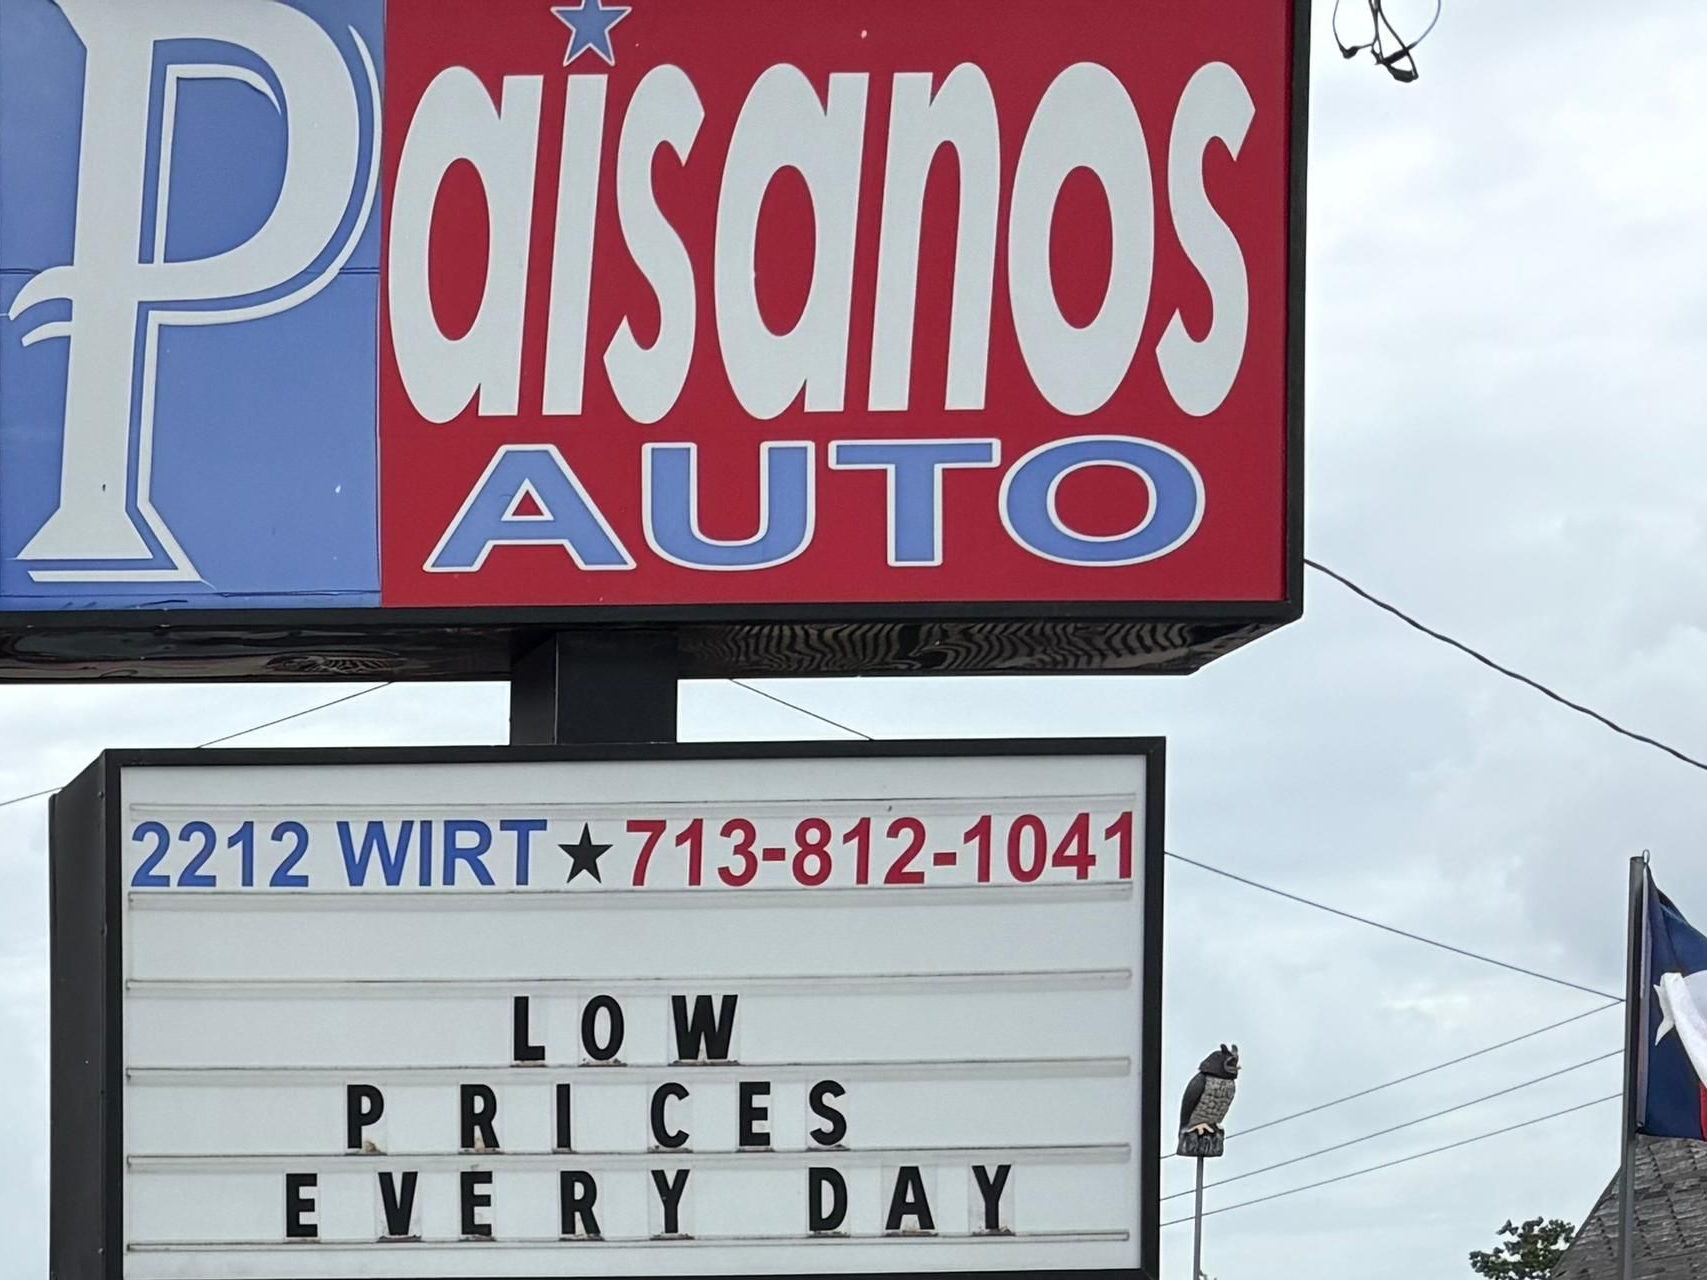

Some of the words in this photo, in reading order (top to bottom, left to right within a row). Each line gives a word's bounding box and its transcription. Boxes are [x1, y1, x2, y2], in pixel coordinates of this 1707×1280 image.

[7, 0, 1257, 584] Paisanos
[421, 435, 1208, 573] AUTO
[130, 818, 310, 889] 2212
[335, 817, 548, 888] WIRT
[624, 809, 1136, 889] 713-812-1041
[512, 992, 738, 1063] LOW
[345, 1079, 849, 1151] PRICES
[284, 1167, 692, 1240] EVERY
[807, 1163, 1013, 1237] DAY
